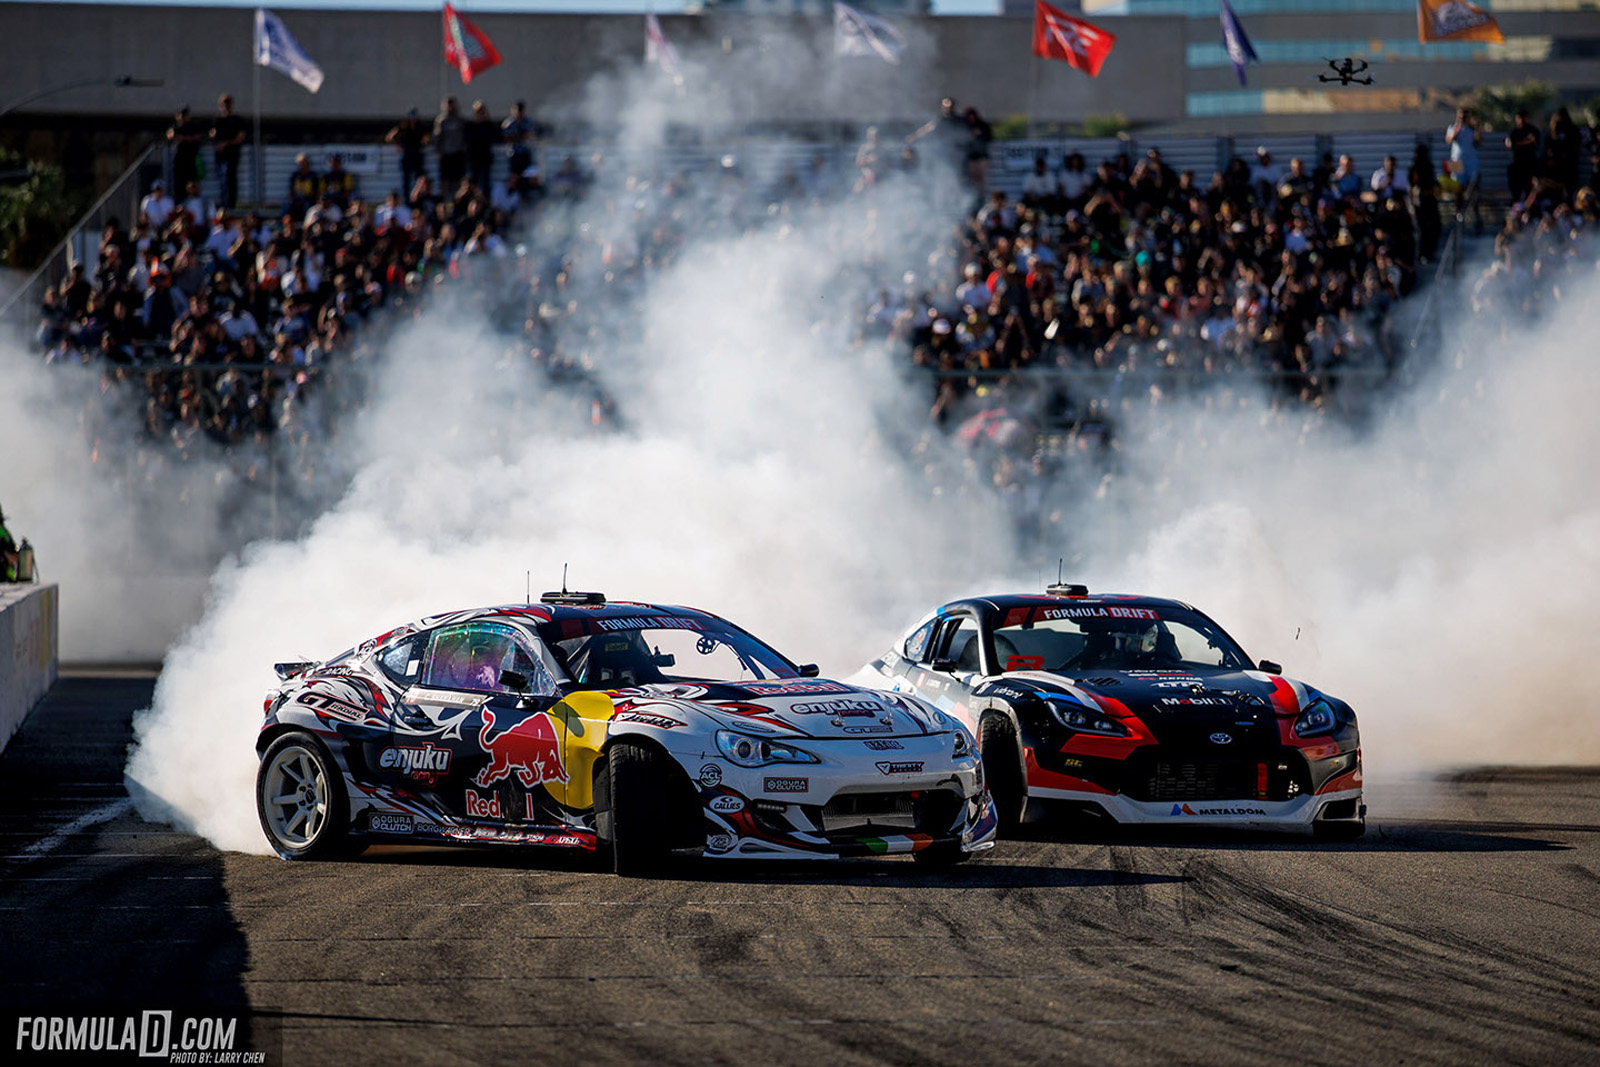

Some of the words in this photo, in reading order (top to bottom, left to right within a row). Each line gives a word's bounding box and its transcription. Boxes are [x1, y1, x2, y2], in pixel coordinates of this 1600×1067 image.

[1044, 607, 1108, 619] FORMULA
[1110, 607, 1156, 619] DRIFT
[597, 617, 661, 631] FORMULA
[659, 617, 703, 630] DRIFT
[745, 685, 798, 695] Red
[800, 683, 850, 693] Bull
[791, 699, 882, 714] enjuku
[1161, 697, 1214, 705] Mobil
[330, 702, 364, 718] RADIAL
[380, 745, 449, 774] enjuku
[411, 770, 434, 784] racing
[465, 788, 500, 818] Red
[714, 802, 741, 810] CALLIES
[1199, 808, 1267, 816] METALDOM
[380, 815, 411, 823] OGURA
[380, 823, 412, 831] CLUTCH
[417, 824, 471, 836] BORGWARNER
